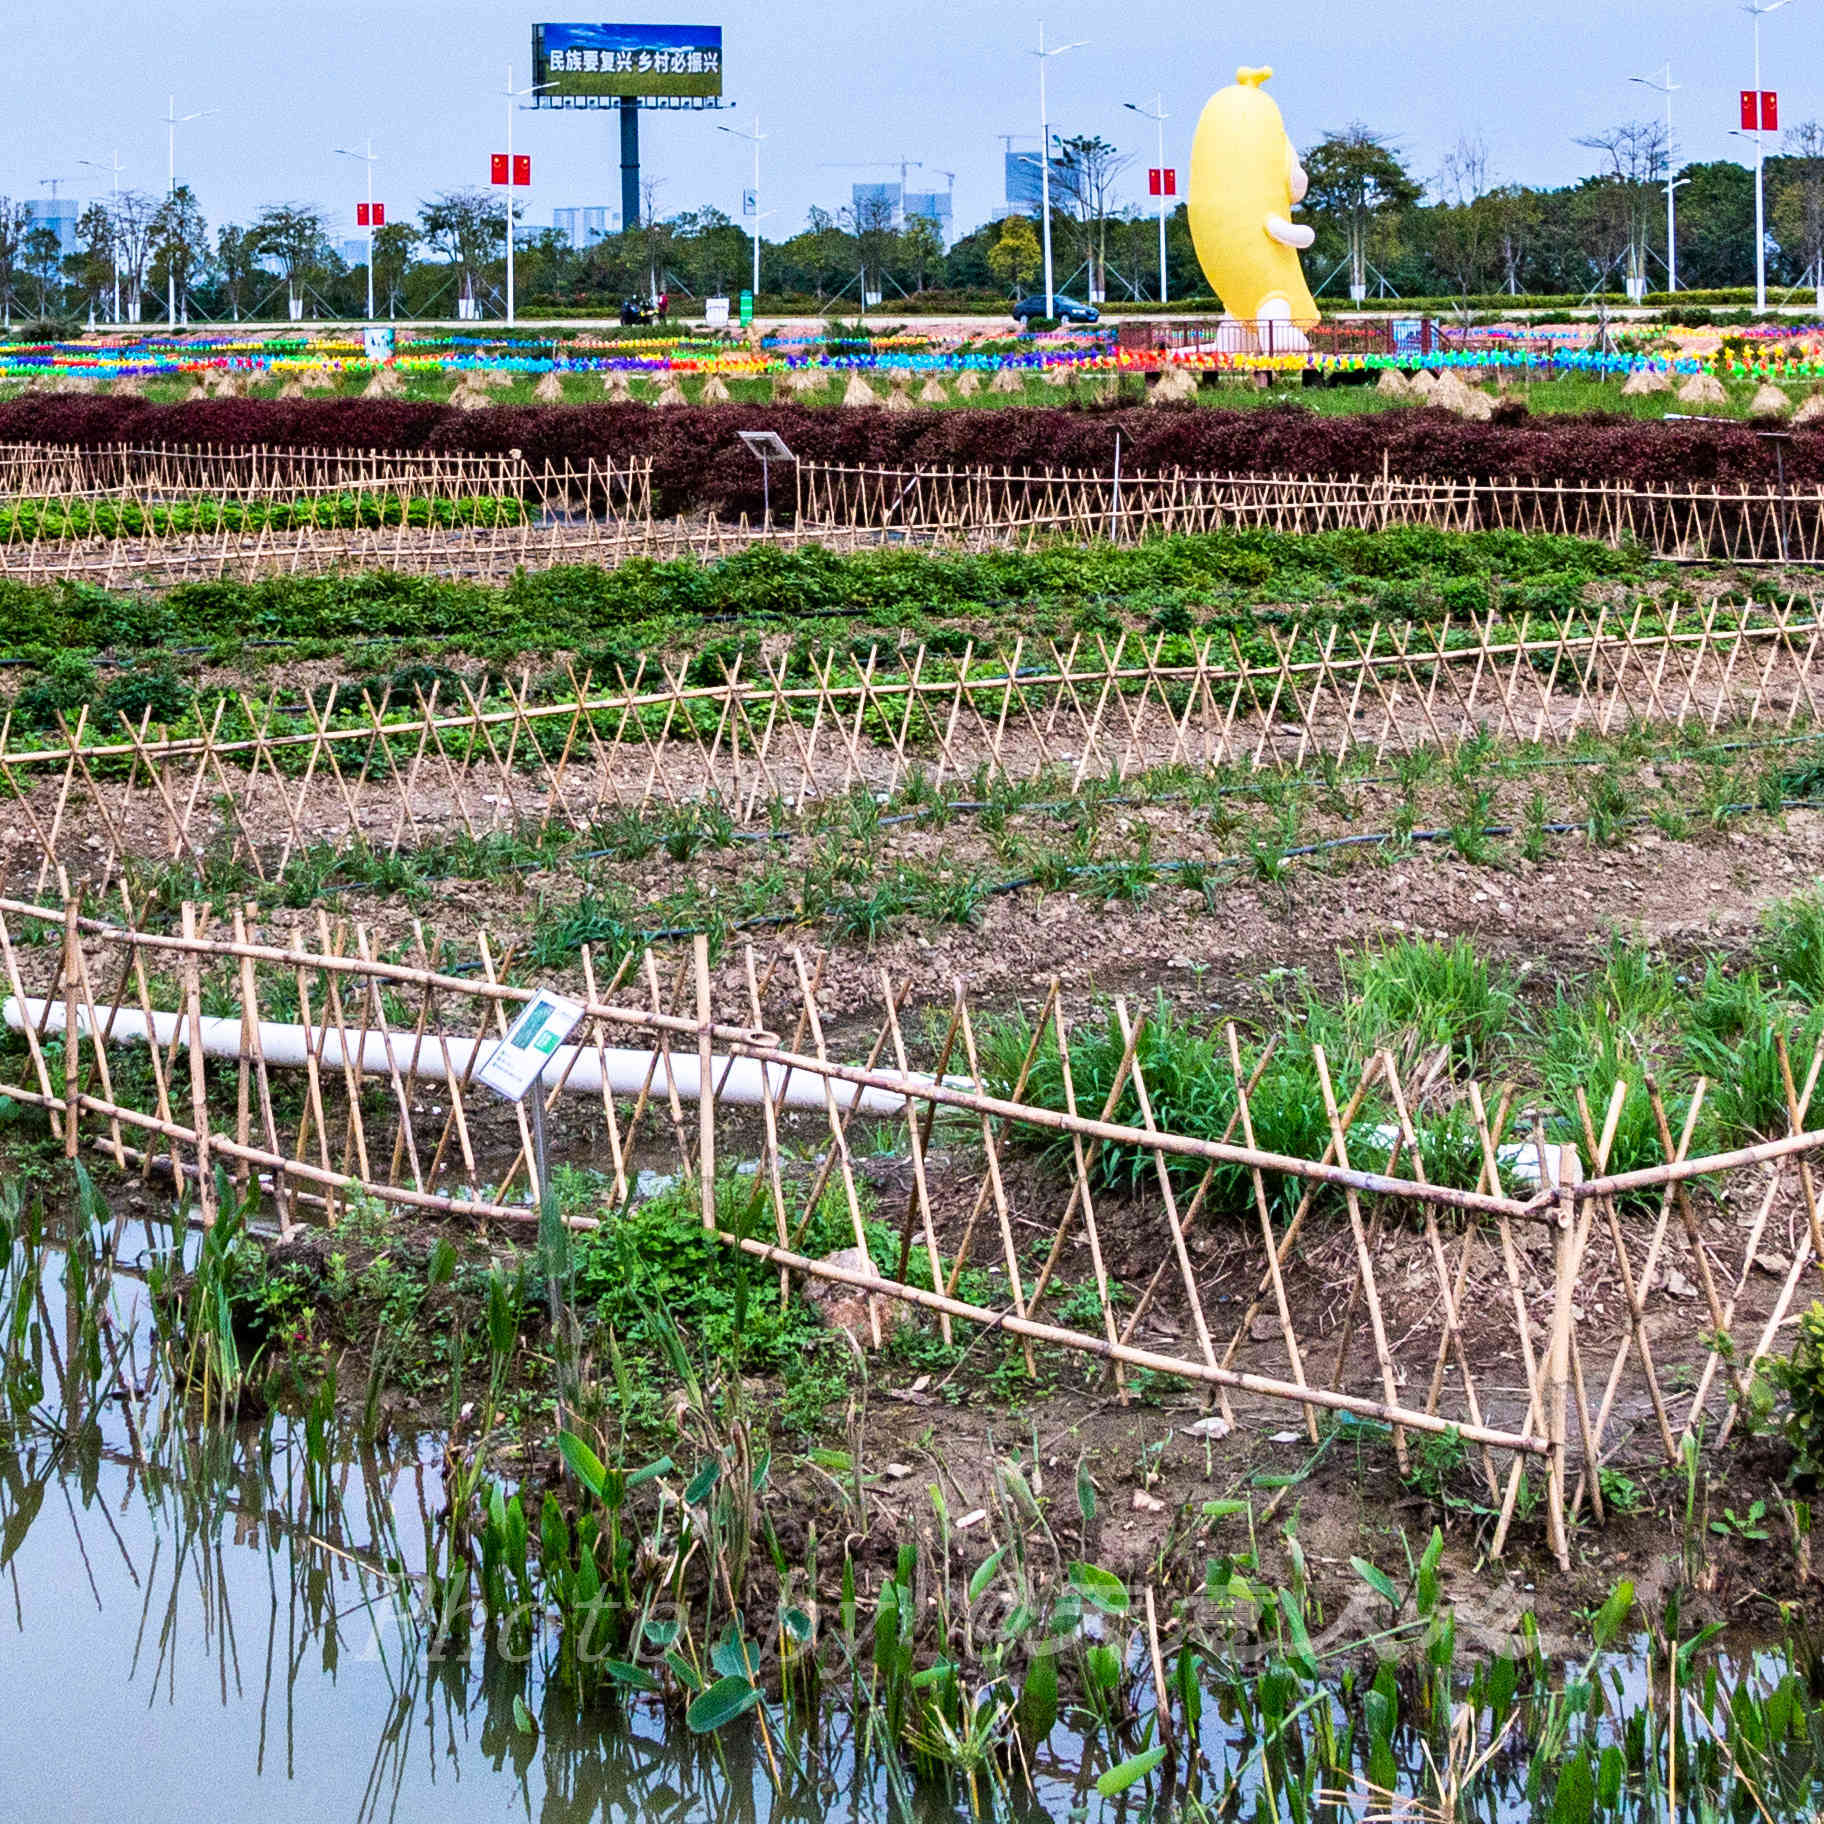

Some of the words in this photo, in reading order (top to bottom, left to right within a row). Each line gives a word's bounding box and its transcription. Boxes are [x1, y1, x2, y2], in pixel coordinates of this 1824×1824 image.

[549, 49, 632, 73] 民族要复兴
[637, 50, 718, 74] 乡村必振兴
